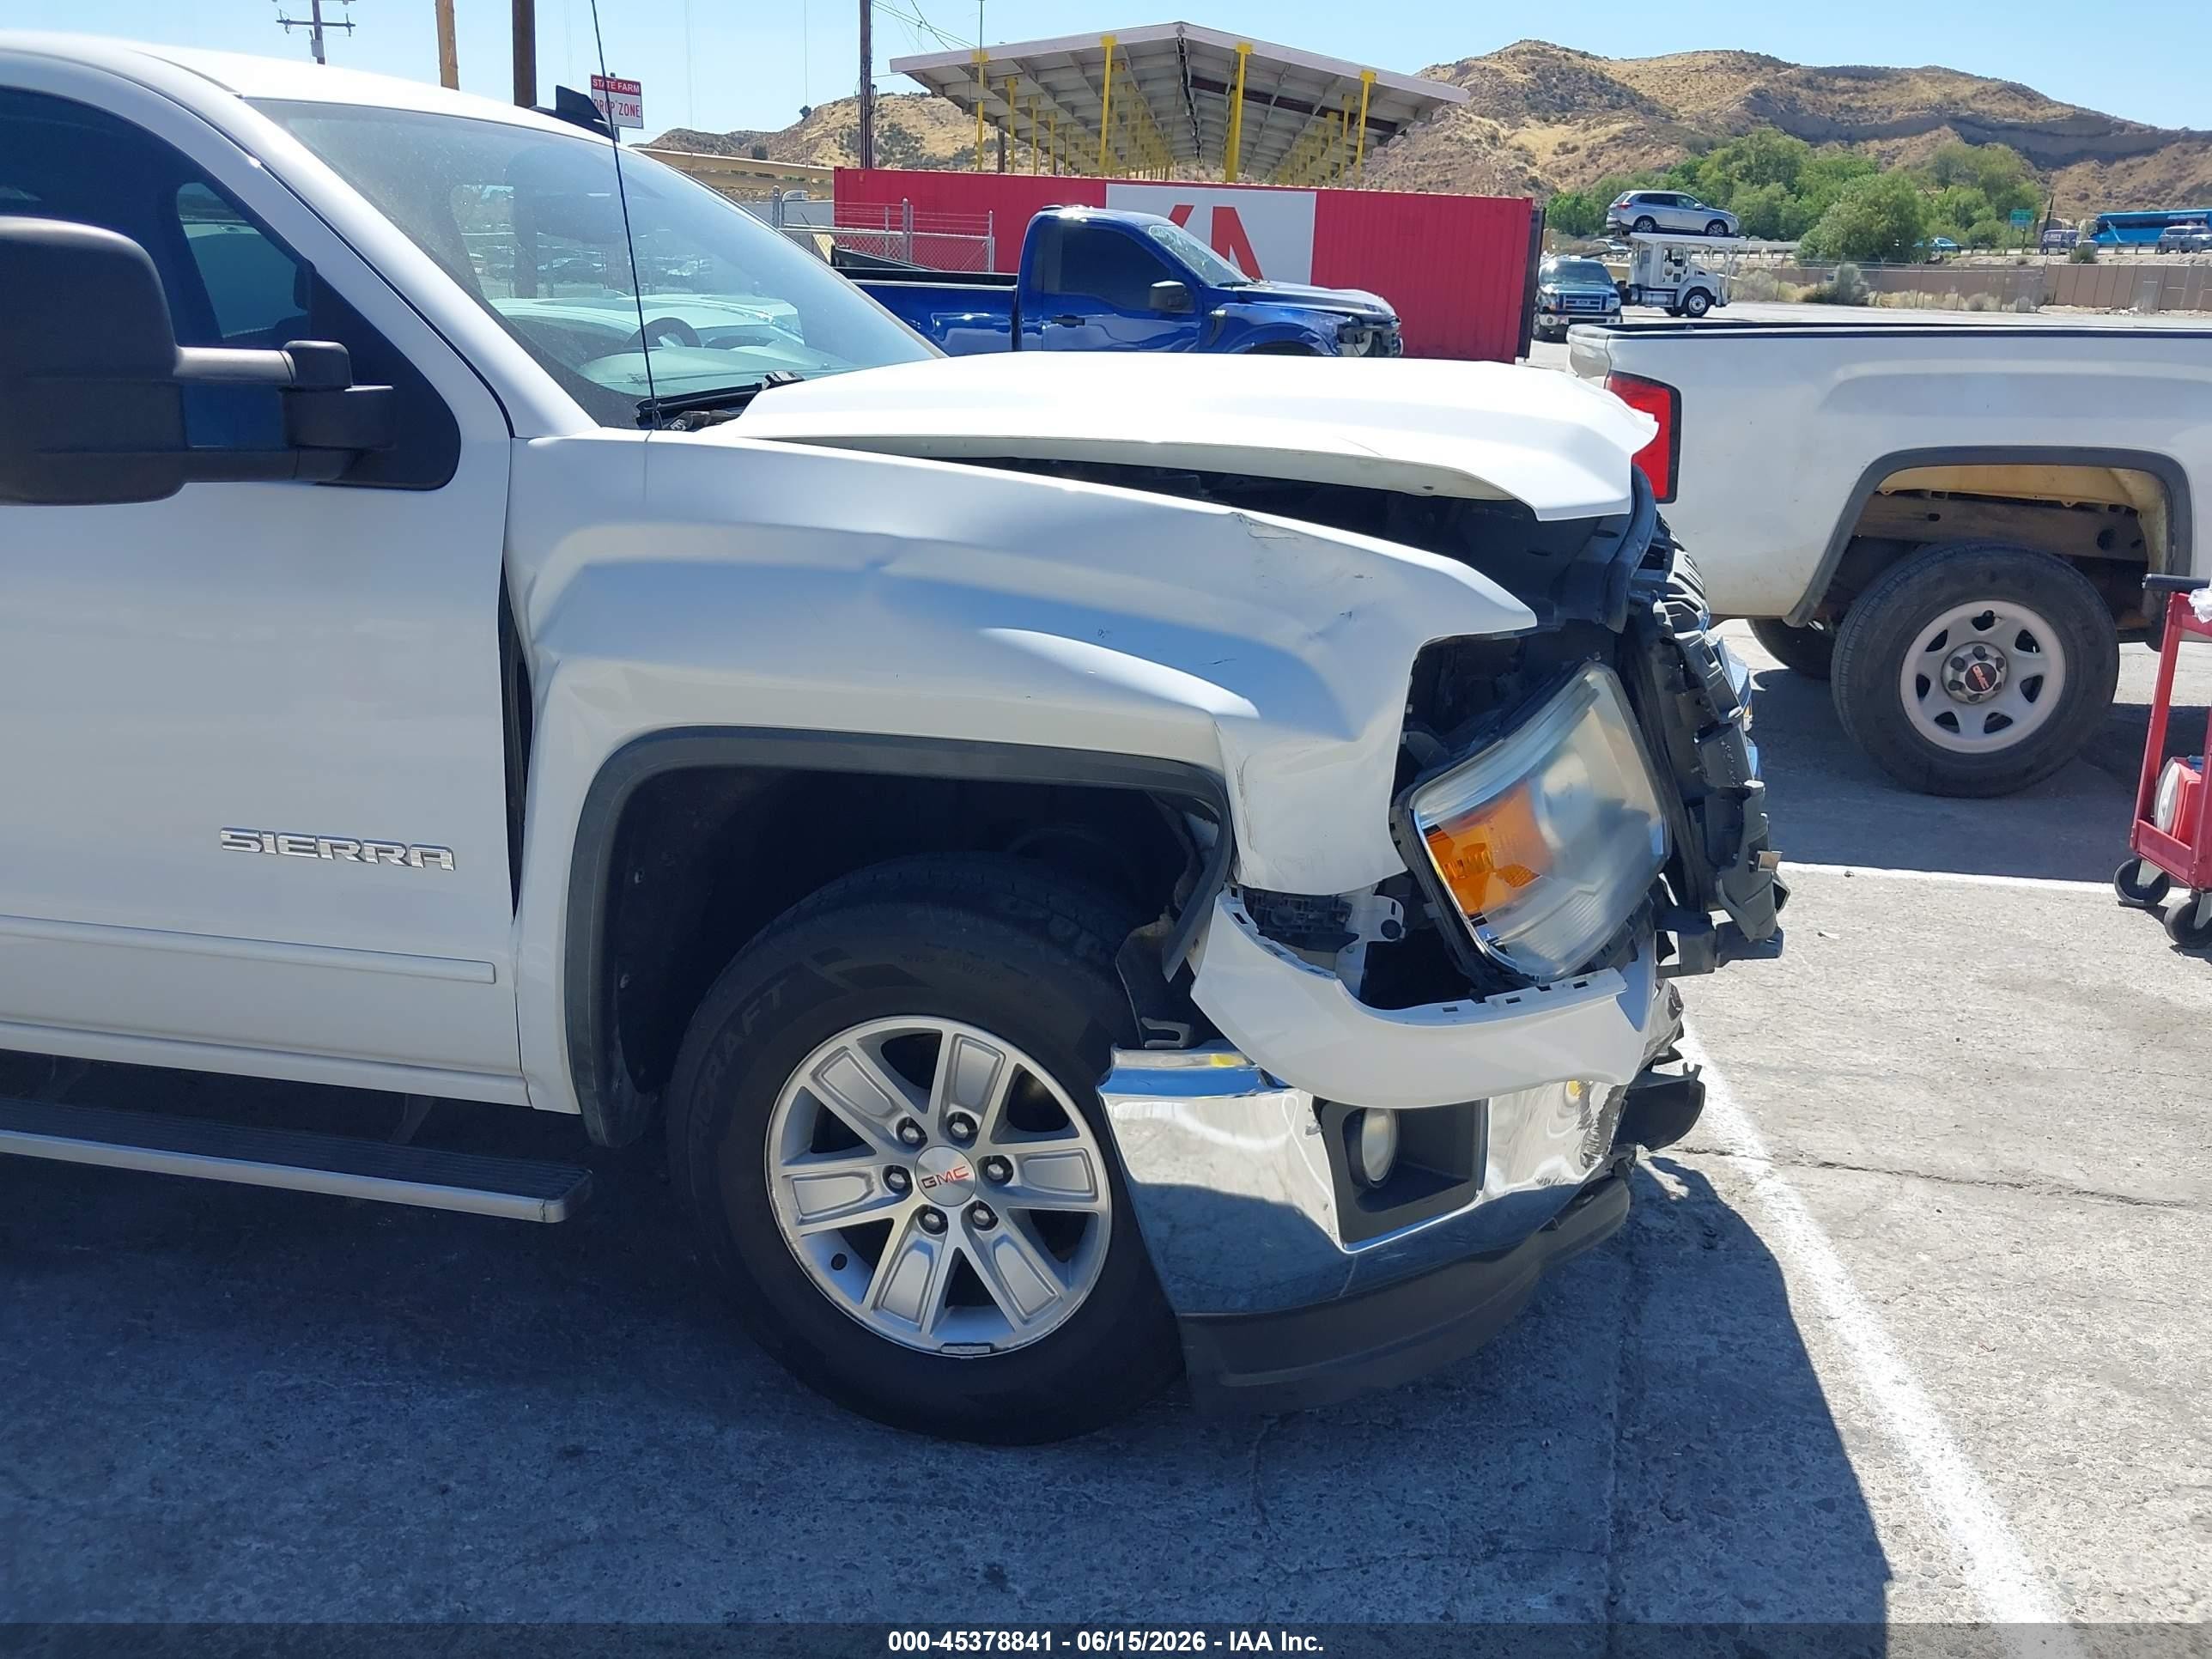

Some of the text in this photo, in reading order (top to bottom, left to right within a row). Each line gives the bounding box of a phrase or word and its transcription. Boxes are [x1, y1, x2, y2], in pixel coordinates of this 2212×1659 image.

[617, 82, 640, 94] FARM
[618, 102, 641, 118] ZONE
[220, 827, 456, 872] SIERRA
[921, 1165, 969, 1189] GMC
